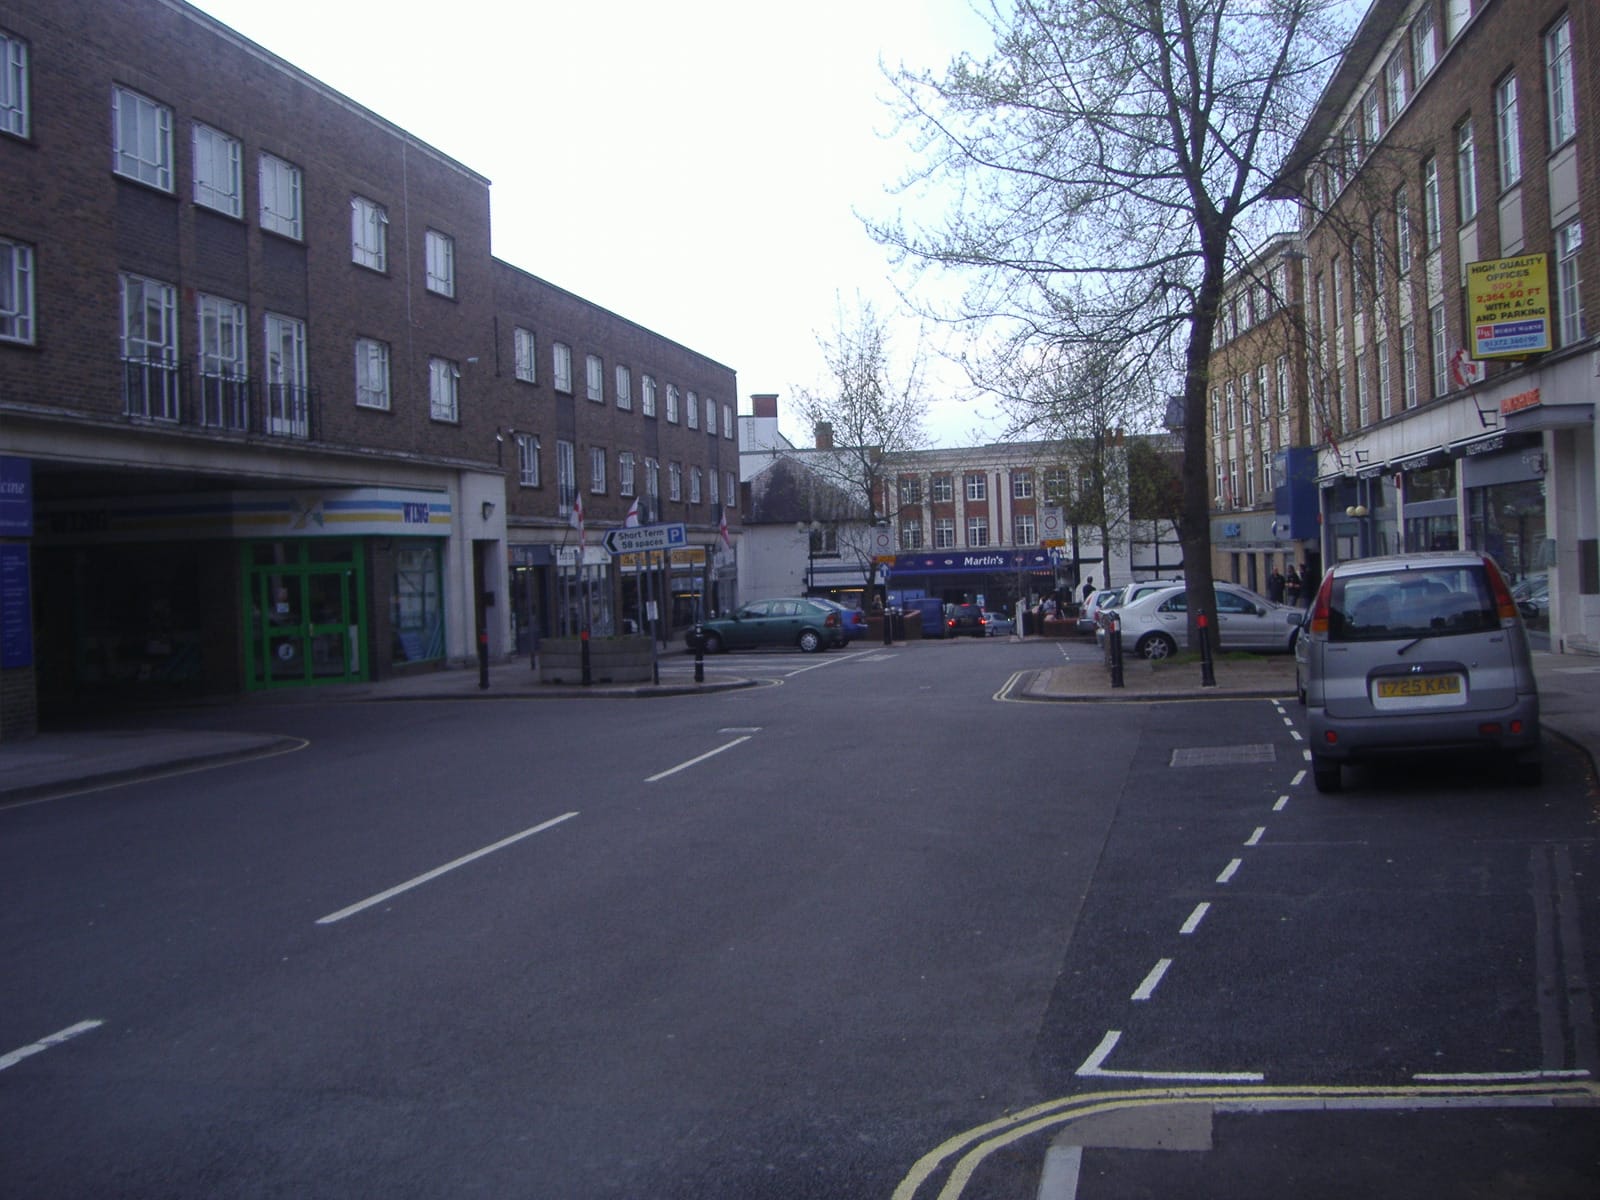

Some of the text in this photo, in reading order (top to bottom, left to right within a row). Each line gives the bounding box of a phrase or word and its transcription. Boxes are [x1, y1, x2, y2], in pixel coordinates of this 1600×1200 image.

[1472, 257, 1542, 274] HIGH QUALITY
[1486, 269, 1529, 281] OFFICES
[1527, 287, 1541, 296] FT
[1485, 302, 1510, 311] WITH
[1476, 307, 1545, 322] AND PARKING
[403, 502, 429, 523] WING
[618, 531, 642, 540] Short
[644, 529, 665, 537] Term
[635, 539, 664, 548] spaces
[964, 556, 1004, 566] Martin's
